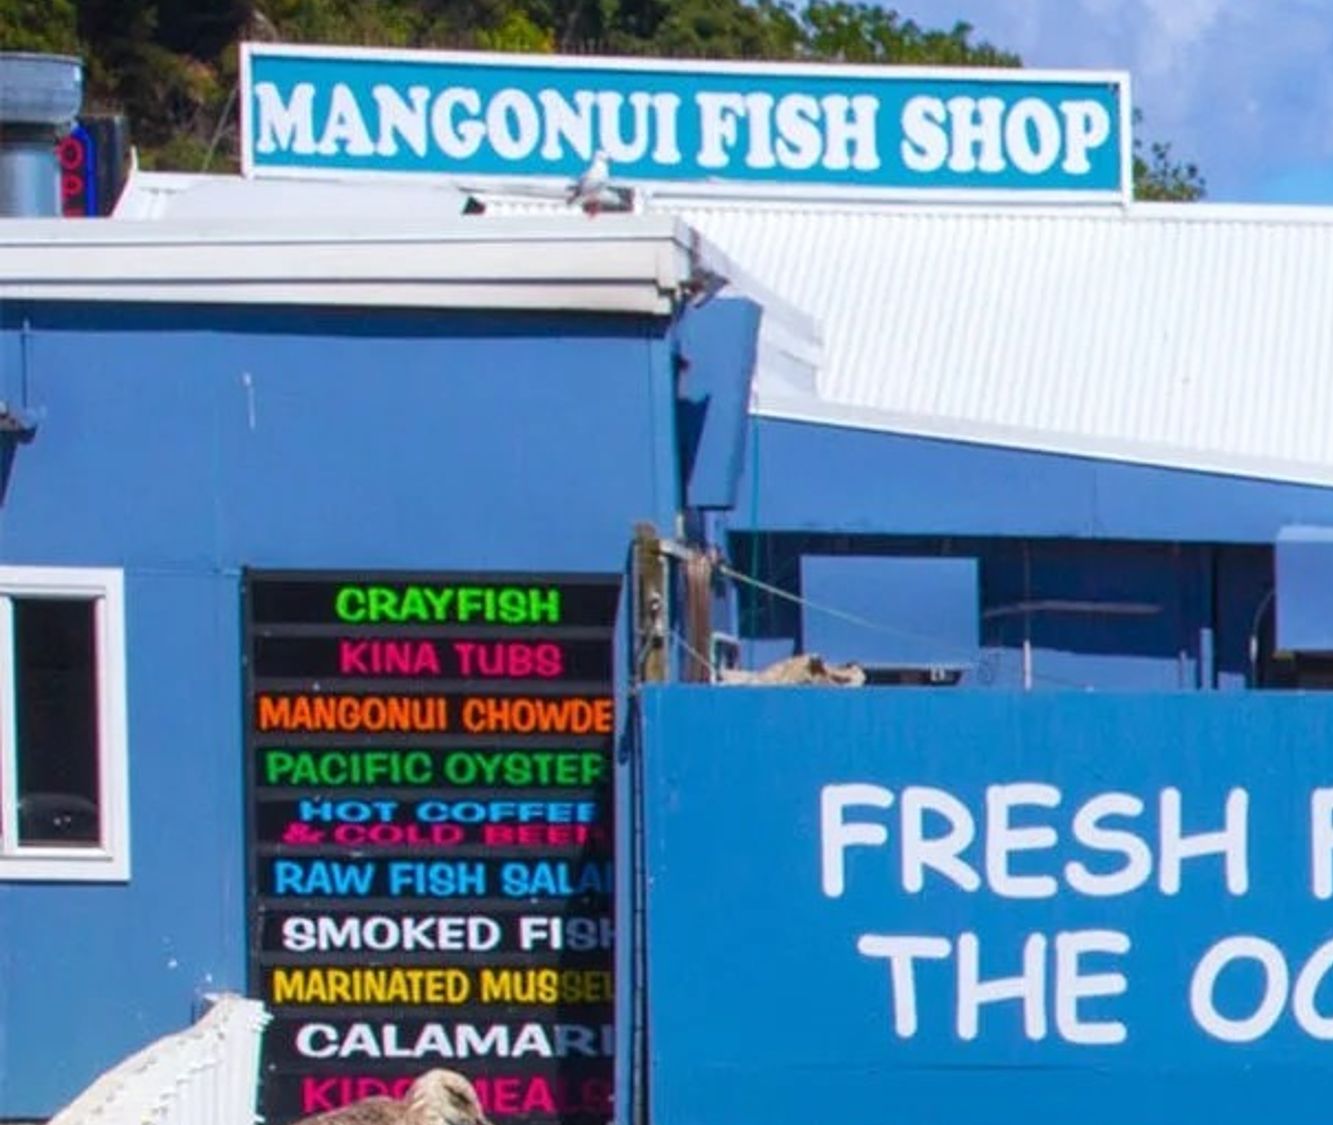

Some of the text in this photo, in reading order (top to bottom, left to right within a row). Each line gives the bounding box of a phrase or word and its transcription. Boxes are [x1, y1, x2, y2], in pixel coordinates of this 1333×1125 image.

[255, 83, 1111, 176] MANGONUI FISH SHOP
[335, 588, 560, 623] CRAYFISH
[340, 643, 563, 677] KINA TUBS
[258, 697, 448, 732] MANGONUI
[265, 752, 432, 785] PACIFIC
[299, 801, 597, 822] HOT COFFEE
[332, 825, 464, 844] COLD
[820, 785, 1248, 898] FRESH
[275, 862, 373, 894] RAW
[389, 862, 486, 895] FISH
[282, 917, 500, 950] SMOKED
[273, 971, 468, 1004] MARINATED
[857, 931, 1129, 1043] THE
[296, 1023, 614, 1059] CALAMARI
